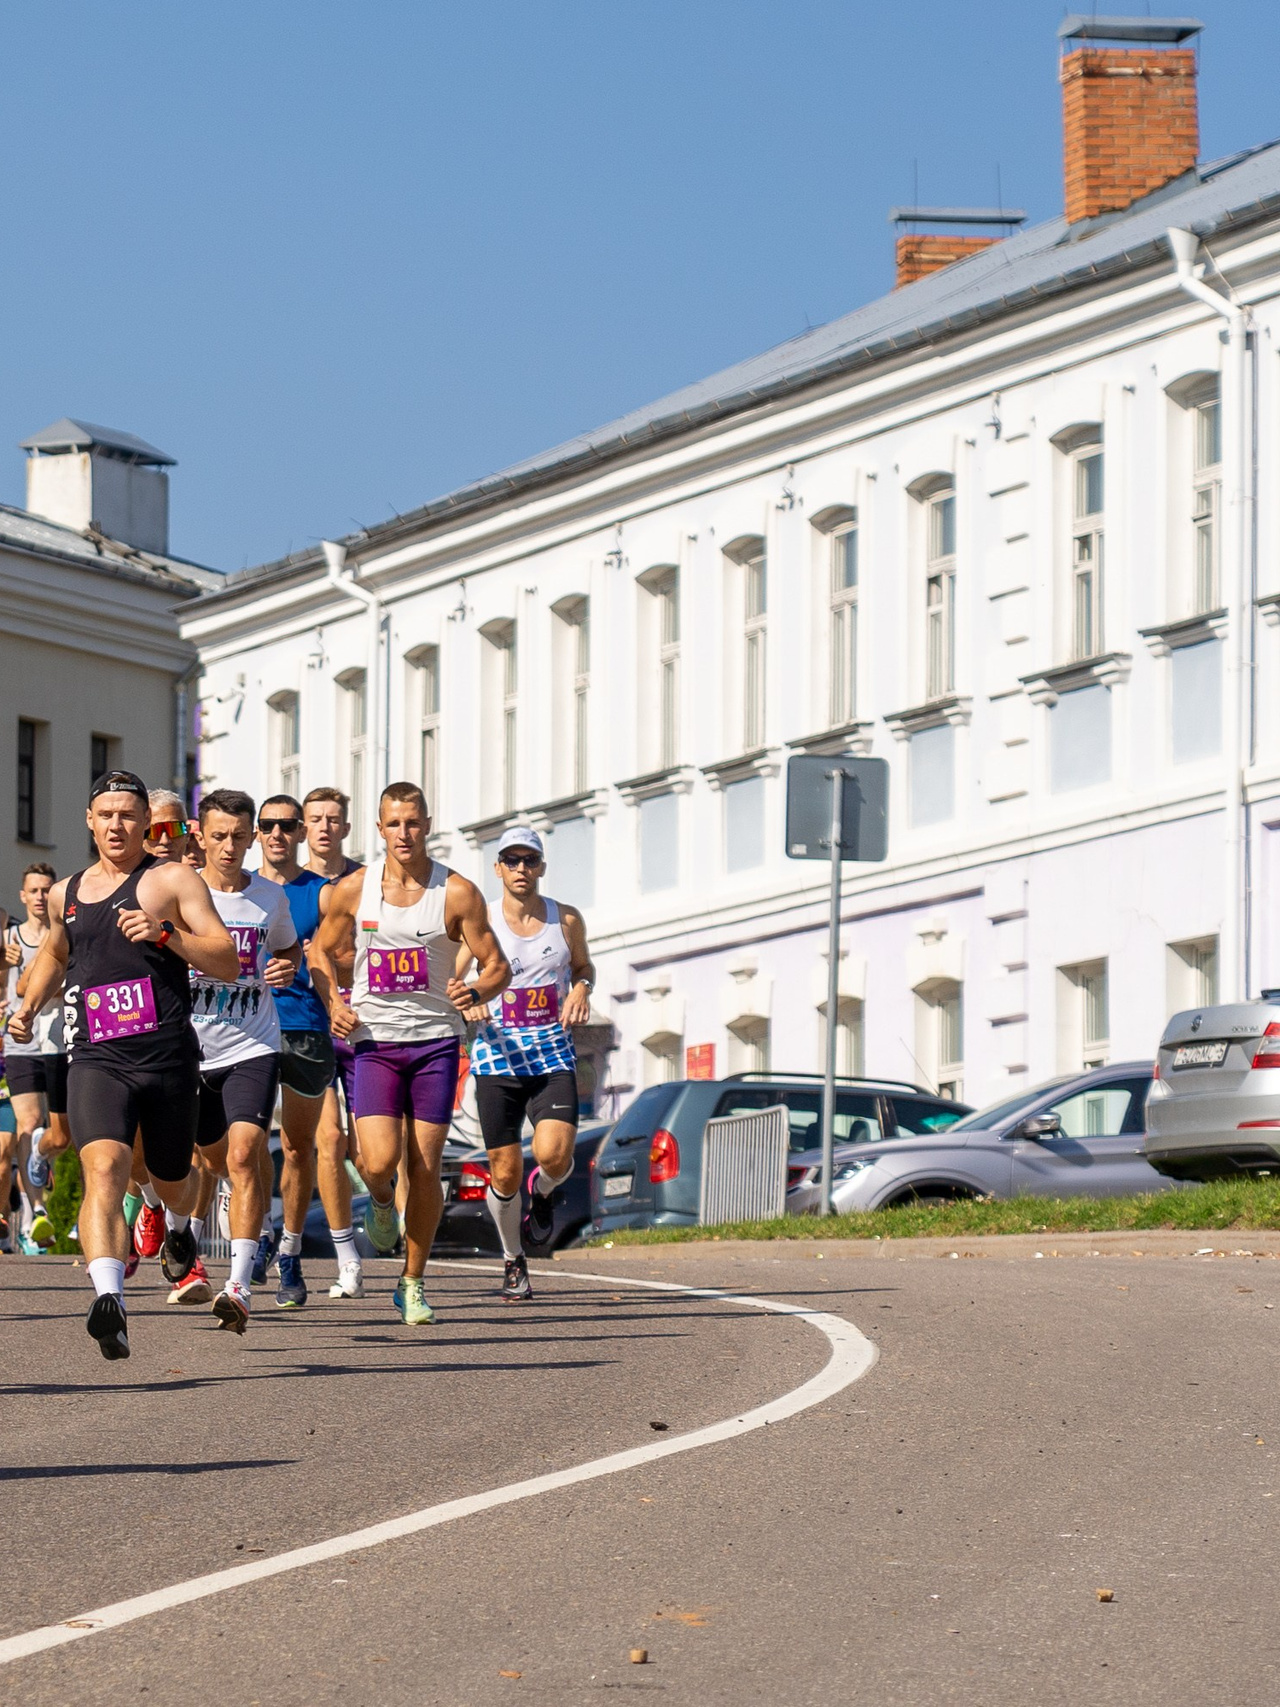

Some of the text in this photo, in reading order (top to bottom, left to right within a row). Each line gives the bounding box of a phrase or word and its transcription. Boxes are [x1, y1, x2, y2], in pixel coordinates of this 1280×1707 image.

[387, 951, 419, 973] 161
[396, 975, 415, 983] Артур
[106, 983, 144, 1013] 331
[527, 988, 548, 1009] 26
